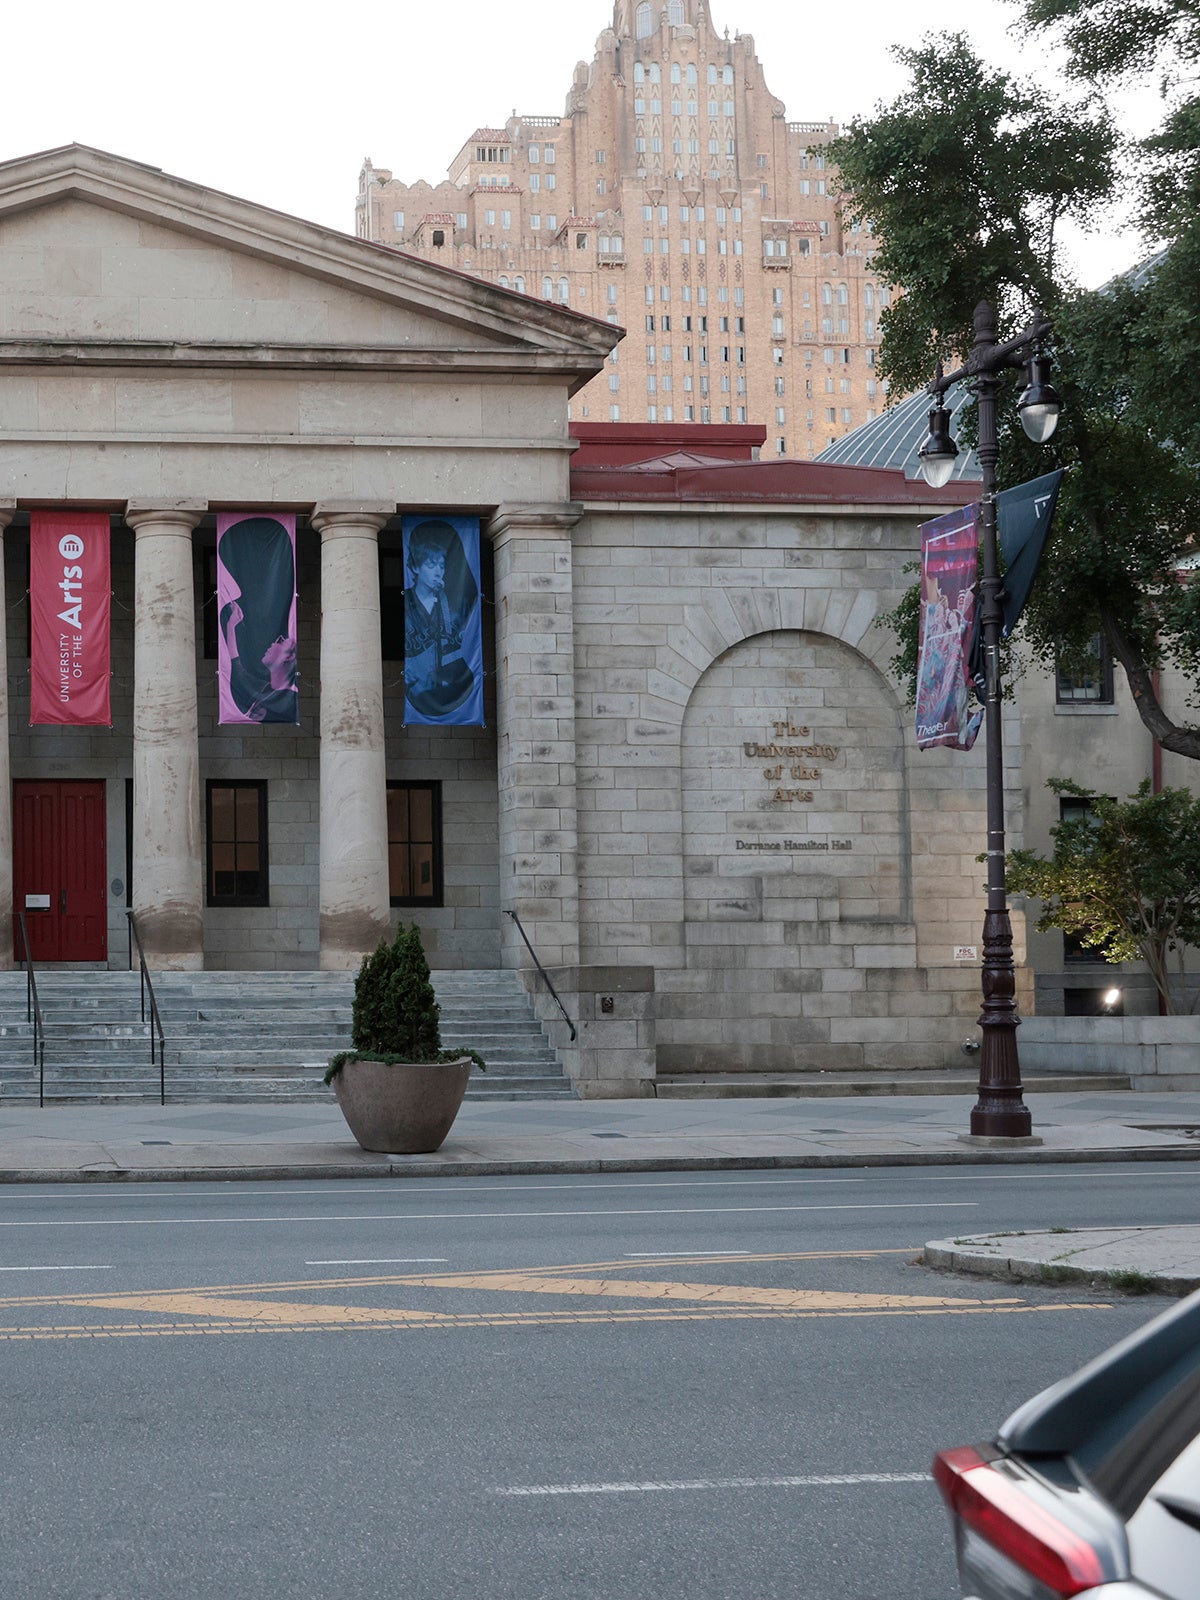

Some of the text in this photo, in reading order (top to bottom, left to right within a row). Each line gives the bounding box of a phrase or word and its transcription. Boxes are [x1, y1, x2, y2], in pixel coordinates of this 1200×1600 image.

[56, 565, 83, 630] Arts
[72, 634, 83, 678] OF THE
[60, 633, 70, 703] UNIVERSITY
[772, 721, 810, 737] The
[743, 742, 839, 761] University
[763, 764, 822, 780] of the
[772, 787, 814, 802] Arts
[736, 840, 852, 850] Dorrance Hamilton Hall
